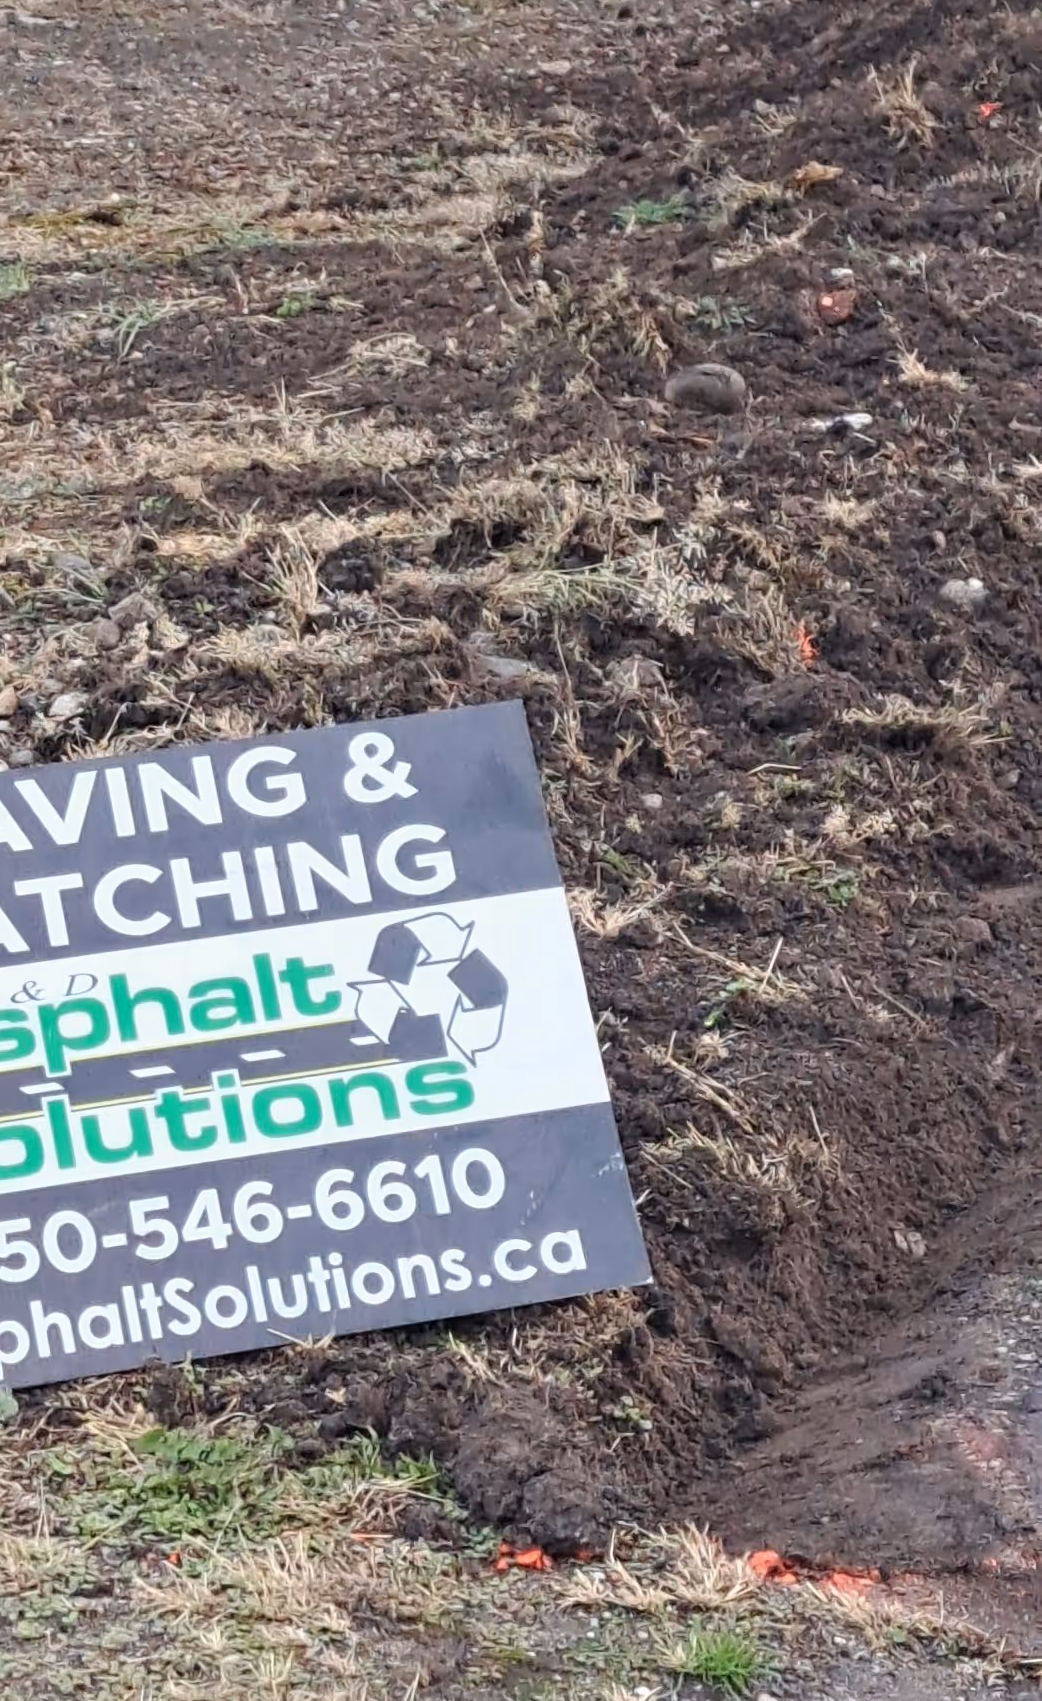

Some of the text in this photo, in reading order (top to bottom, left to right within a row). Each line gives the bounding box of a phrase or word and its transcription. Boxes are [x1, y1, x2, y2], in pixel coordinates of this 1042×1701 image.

[343, 732, 418, 804] &
[10, 979, 45, 1004] &
[64, 973, 99, 997] D
